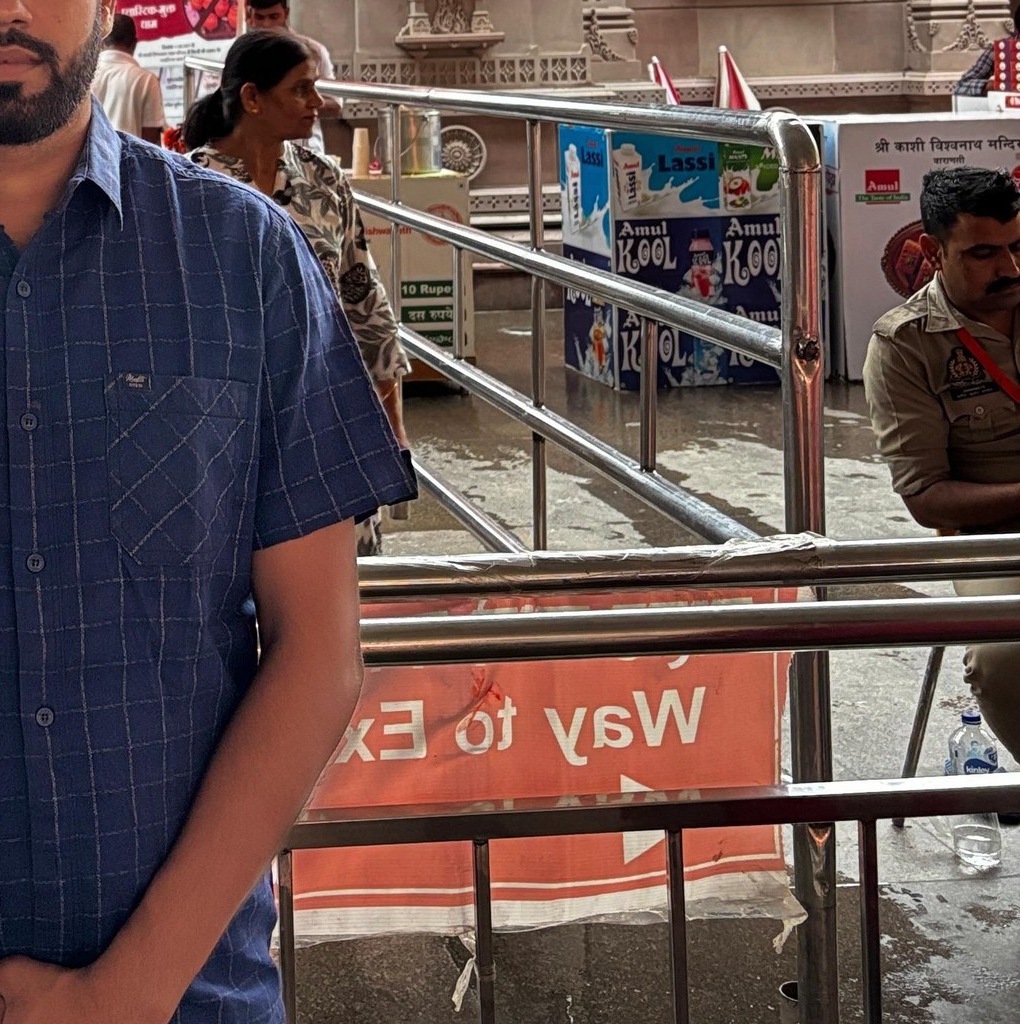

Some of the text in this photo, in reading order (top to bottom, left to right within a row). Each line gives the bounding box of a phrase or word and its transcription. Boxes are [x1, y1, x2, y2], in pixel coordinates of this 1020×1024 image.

[875, 137, 890, 153] श्री
[894, 137, 925, 152] काशी
[930, 137, 983, 152] विश्वनाथ
[581, 146, 604, 168] Lassi
[658, 152, 715, 173] Lassi
[867, 180, 899, 192] Amul
[619, 220, 668, 237] Amul
[726, 217, 781, 237] Amul
[617, 236, 678, 274] KOOL
[723, 239, 781, 286] KOO
[402, 284, 453, 296] 10 Rupe
[735, 305, 781, 322] Amu
[621, 329, 686, 372] KOL
[965, 765, 990, 774] kinley
